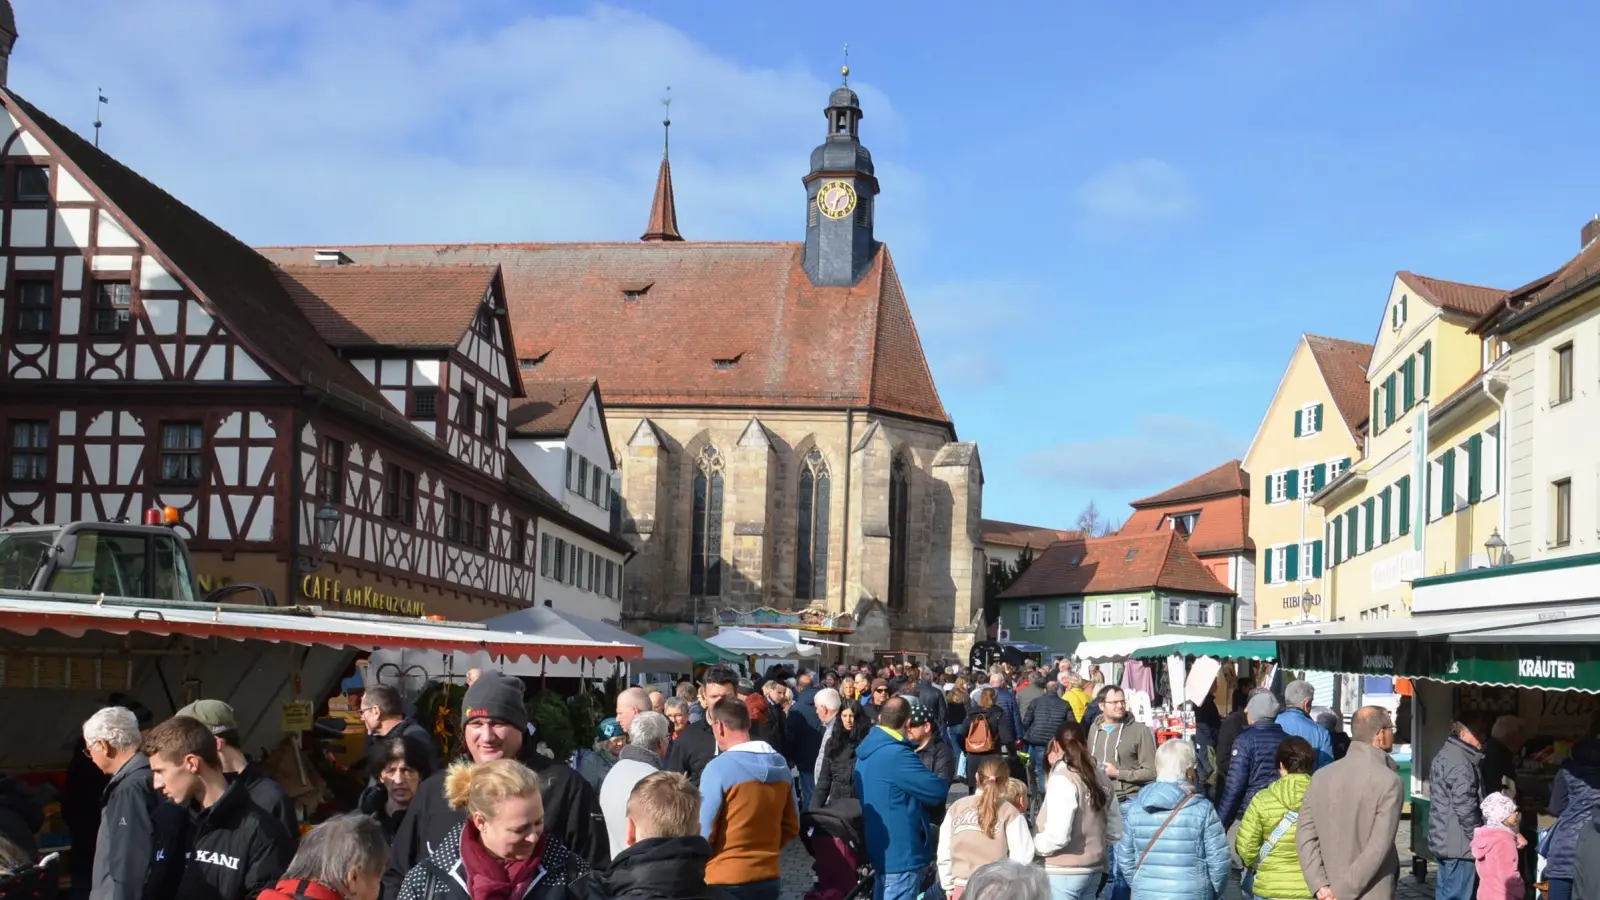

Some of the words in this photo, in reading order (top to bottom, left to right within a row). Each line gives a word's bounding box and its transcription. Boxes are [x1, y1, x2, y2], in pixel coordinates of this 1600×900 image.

[303, 574, 340, 601] CAFE
[1518, 656, 1576, 679] KRÄUTER
[195, 849, 240, 870] KANI
